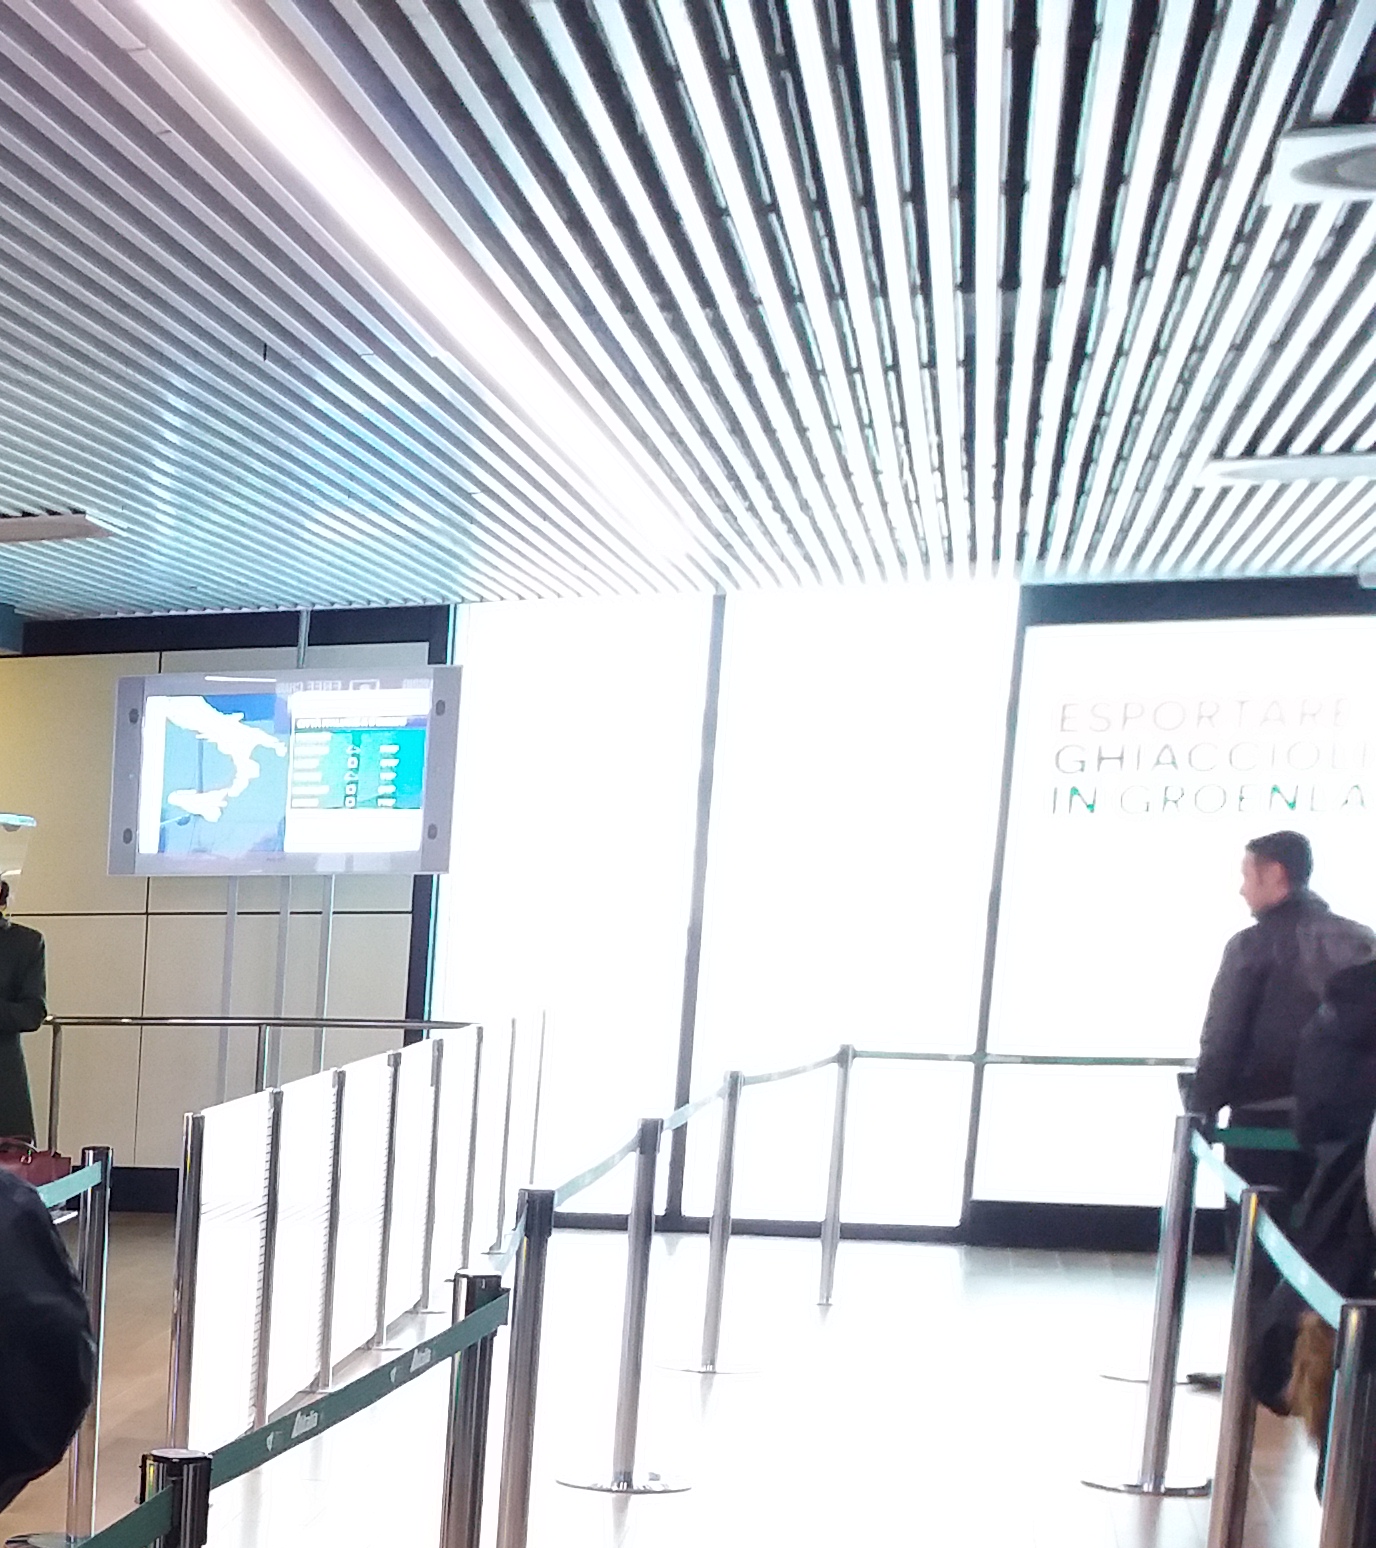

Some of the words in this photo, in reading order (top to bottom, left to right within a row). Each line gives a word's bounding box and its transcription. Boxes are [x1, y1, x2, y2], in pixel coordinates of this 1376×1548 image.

[1059, 698, 1350, 733] ESPORTARE
[1053, 741, 1367, 774] GHIACCIOLI
[1052, 785, 1097, 814] IN
[1119, 783, 1367, 814] GROENLA
